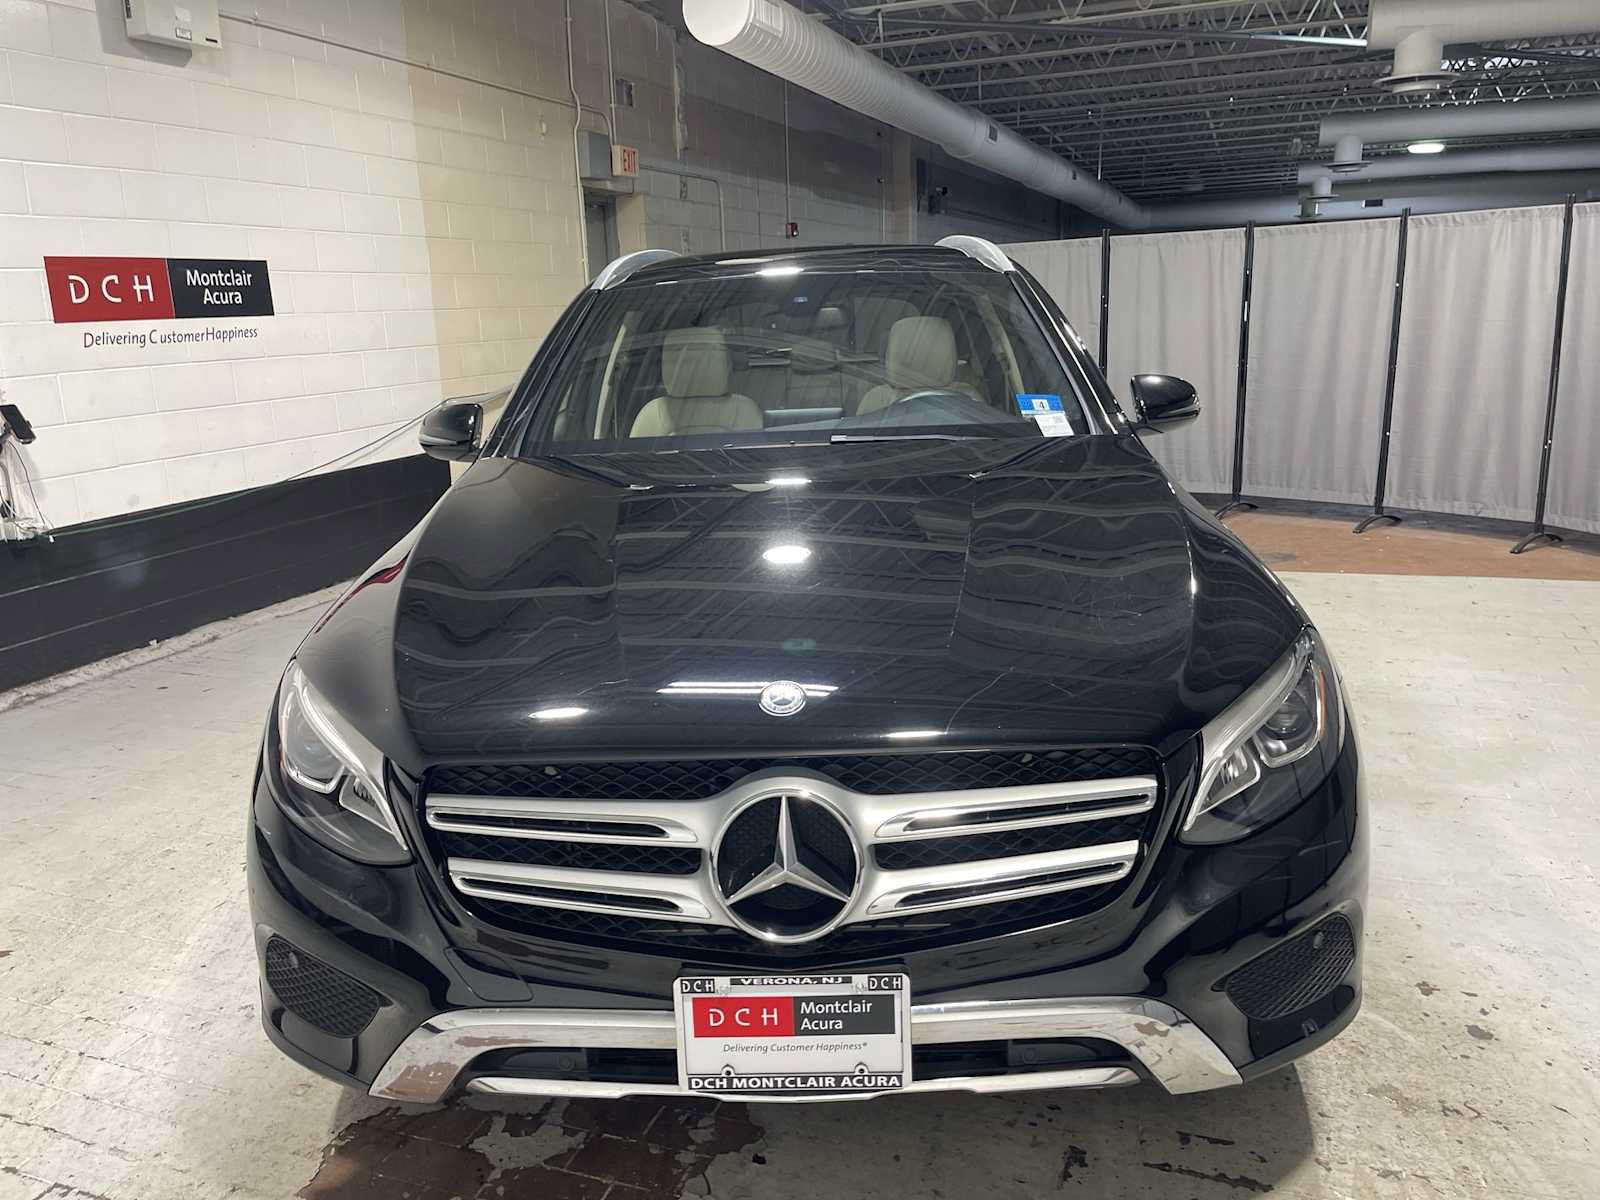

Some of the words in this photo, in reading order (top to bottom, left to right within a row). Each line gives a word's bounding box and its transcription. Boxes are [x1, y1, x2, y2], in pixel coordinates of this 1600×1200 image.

[623, 148, 636, 173] EXIT
[186, 269, 252, 287] Montclair
[68, 274, 154, 304] DCH
[203, 289, 243, 305] Acura
[83, 331, 147, 348] Delivering
[149, 329, 206, 345] Customer
[205, 326, 258, 342] Happiness
[682, 980, 714, 993] DCH
[740, 977, 817, 985] VERONA,
[868, 976, 902, 990] DCH
[800, 1000, 873, 1015] Montclair
[708, 1008, 779, 1027] DCH
[800, 1018, 843, 1031] Acura
[722, 1044, 769, 1055] Delivering
[770, 1042, 814, 1053] Customer
[691, 1078, 729, 1090] DCH
[732, 1076, 836, 1089] MONTCLAIR
[840, 1074, 901, 1088] ACURA
